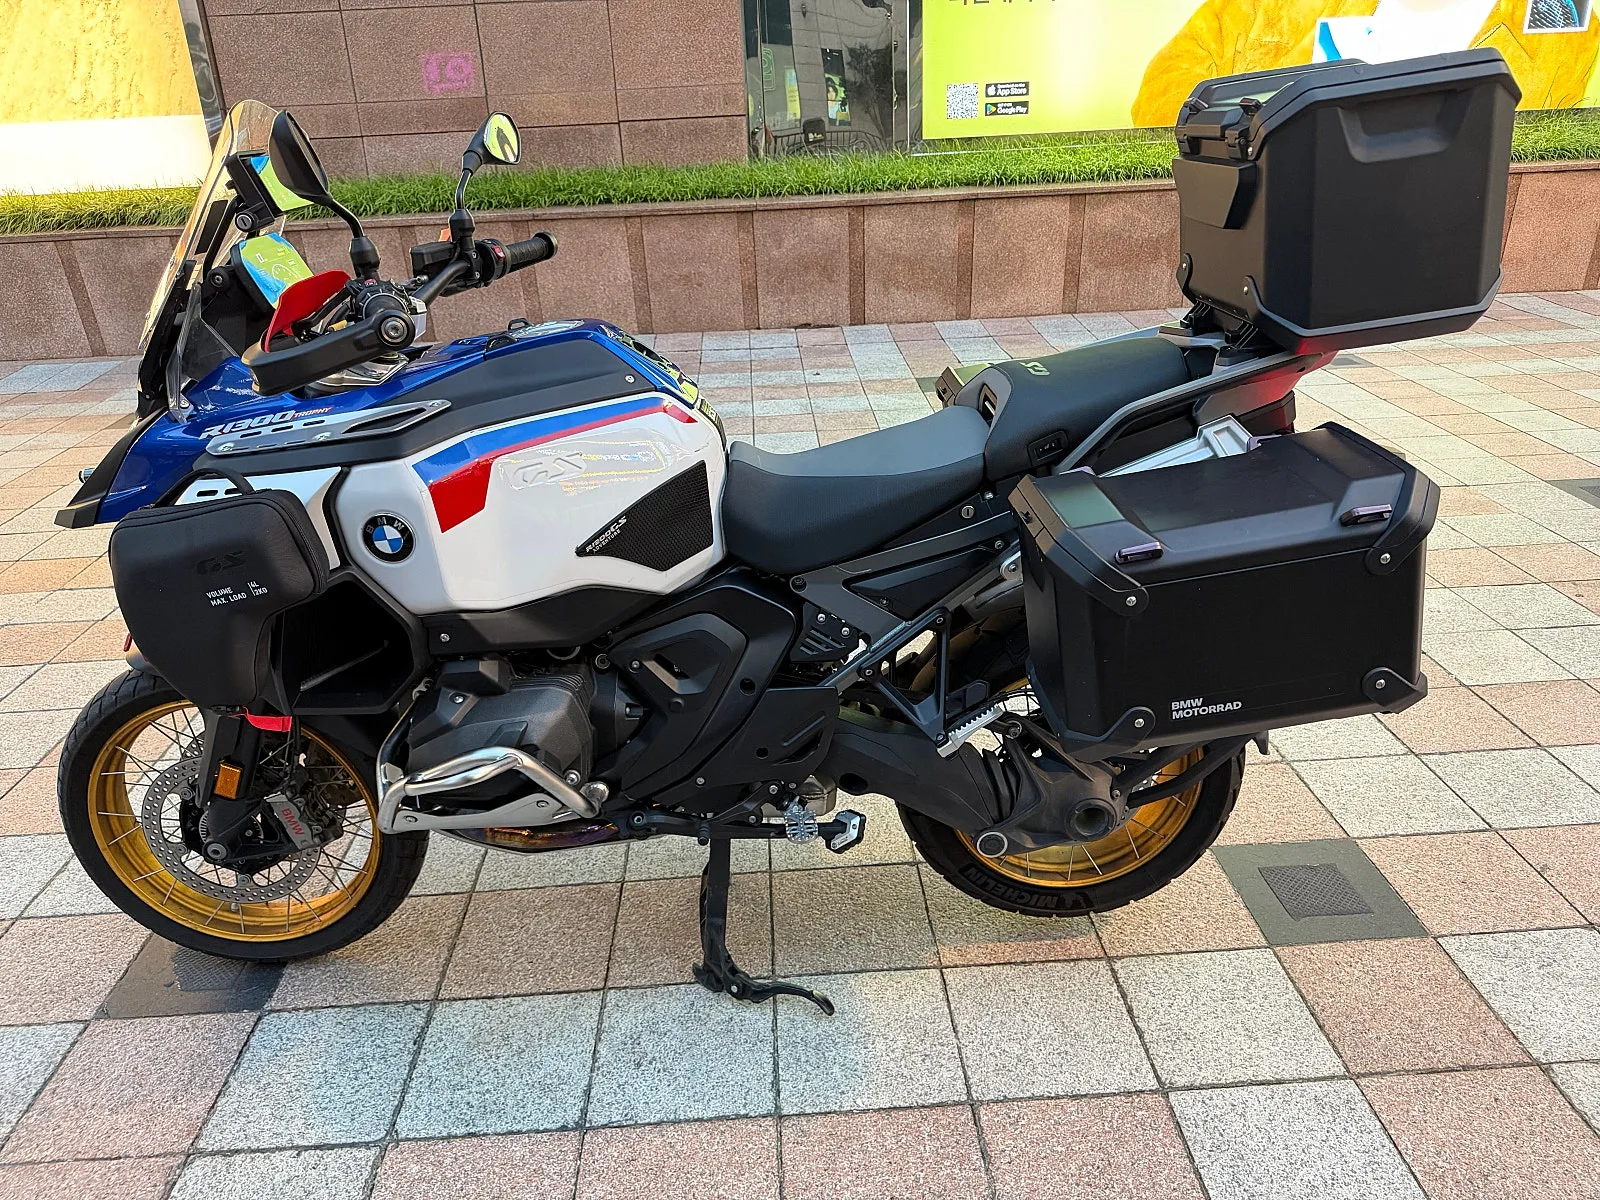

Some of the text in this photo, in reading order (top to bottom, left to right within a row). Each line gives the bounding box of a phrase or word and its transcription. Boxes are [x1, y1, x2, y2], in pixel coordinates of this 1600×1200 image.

[996, 88, 1010, 97] App
[199, 406, 333, 440] R1300 TROPHY
[365, 516, 405, 535] BMW
[592, 528, 621, 554] ADVENTURE
[206, 586, 234, 599] VOLUME
[210, 597, 229, 607] MAX.
[228, 592, 247, 602] LOAD
[1171, 697, 1204, 711] BMW
[1172, 701, 1242, 720] MOTORRAD
[280, 807, 305, 836] BMW
[964, 866, 1059, 908] MICHELIN
